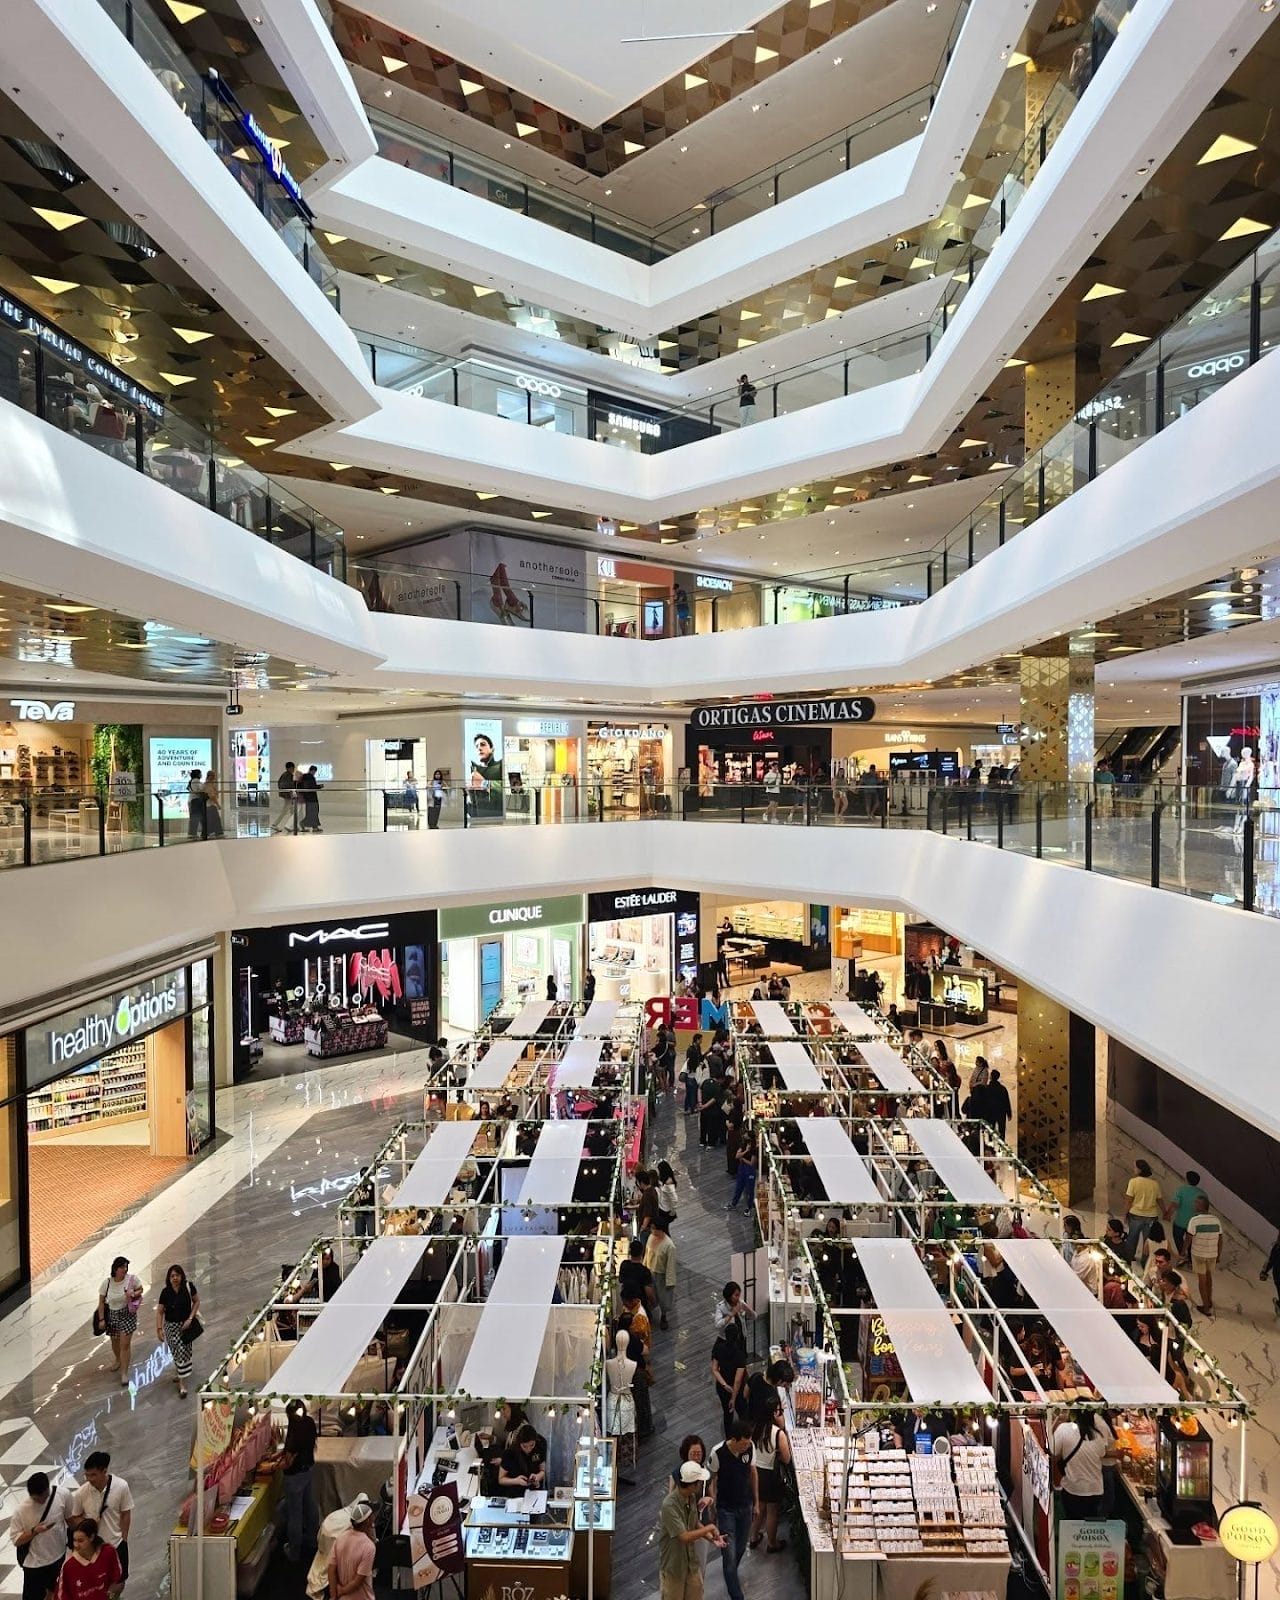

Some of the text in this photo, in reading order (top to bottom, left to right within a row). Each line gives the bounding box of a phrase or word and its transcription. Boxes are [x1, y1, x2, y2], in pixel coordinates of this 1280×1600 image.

[608, 412, 661, 437] SAMSUNG
[519, 558, 579, 577] anothersole
[698, 700, 863, 727] ORTIGAS CINEMAS
[599, 726, 665, 739] GIORDANO
[642, 890, 677, 906] LAUDER
[489, 905, 543, 924] CLINIQUE
[51, 1012, 116, 1065] healthy
[1079, 1527, 1106, 1535] GOOD
[1231, 1524, 1267, 1535] GOOD
